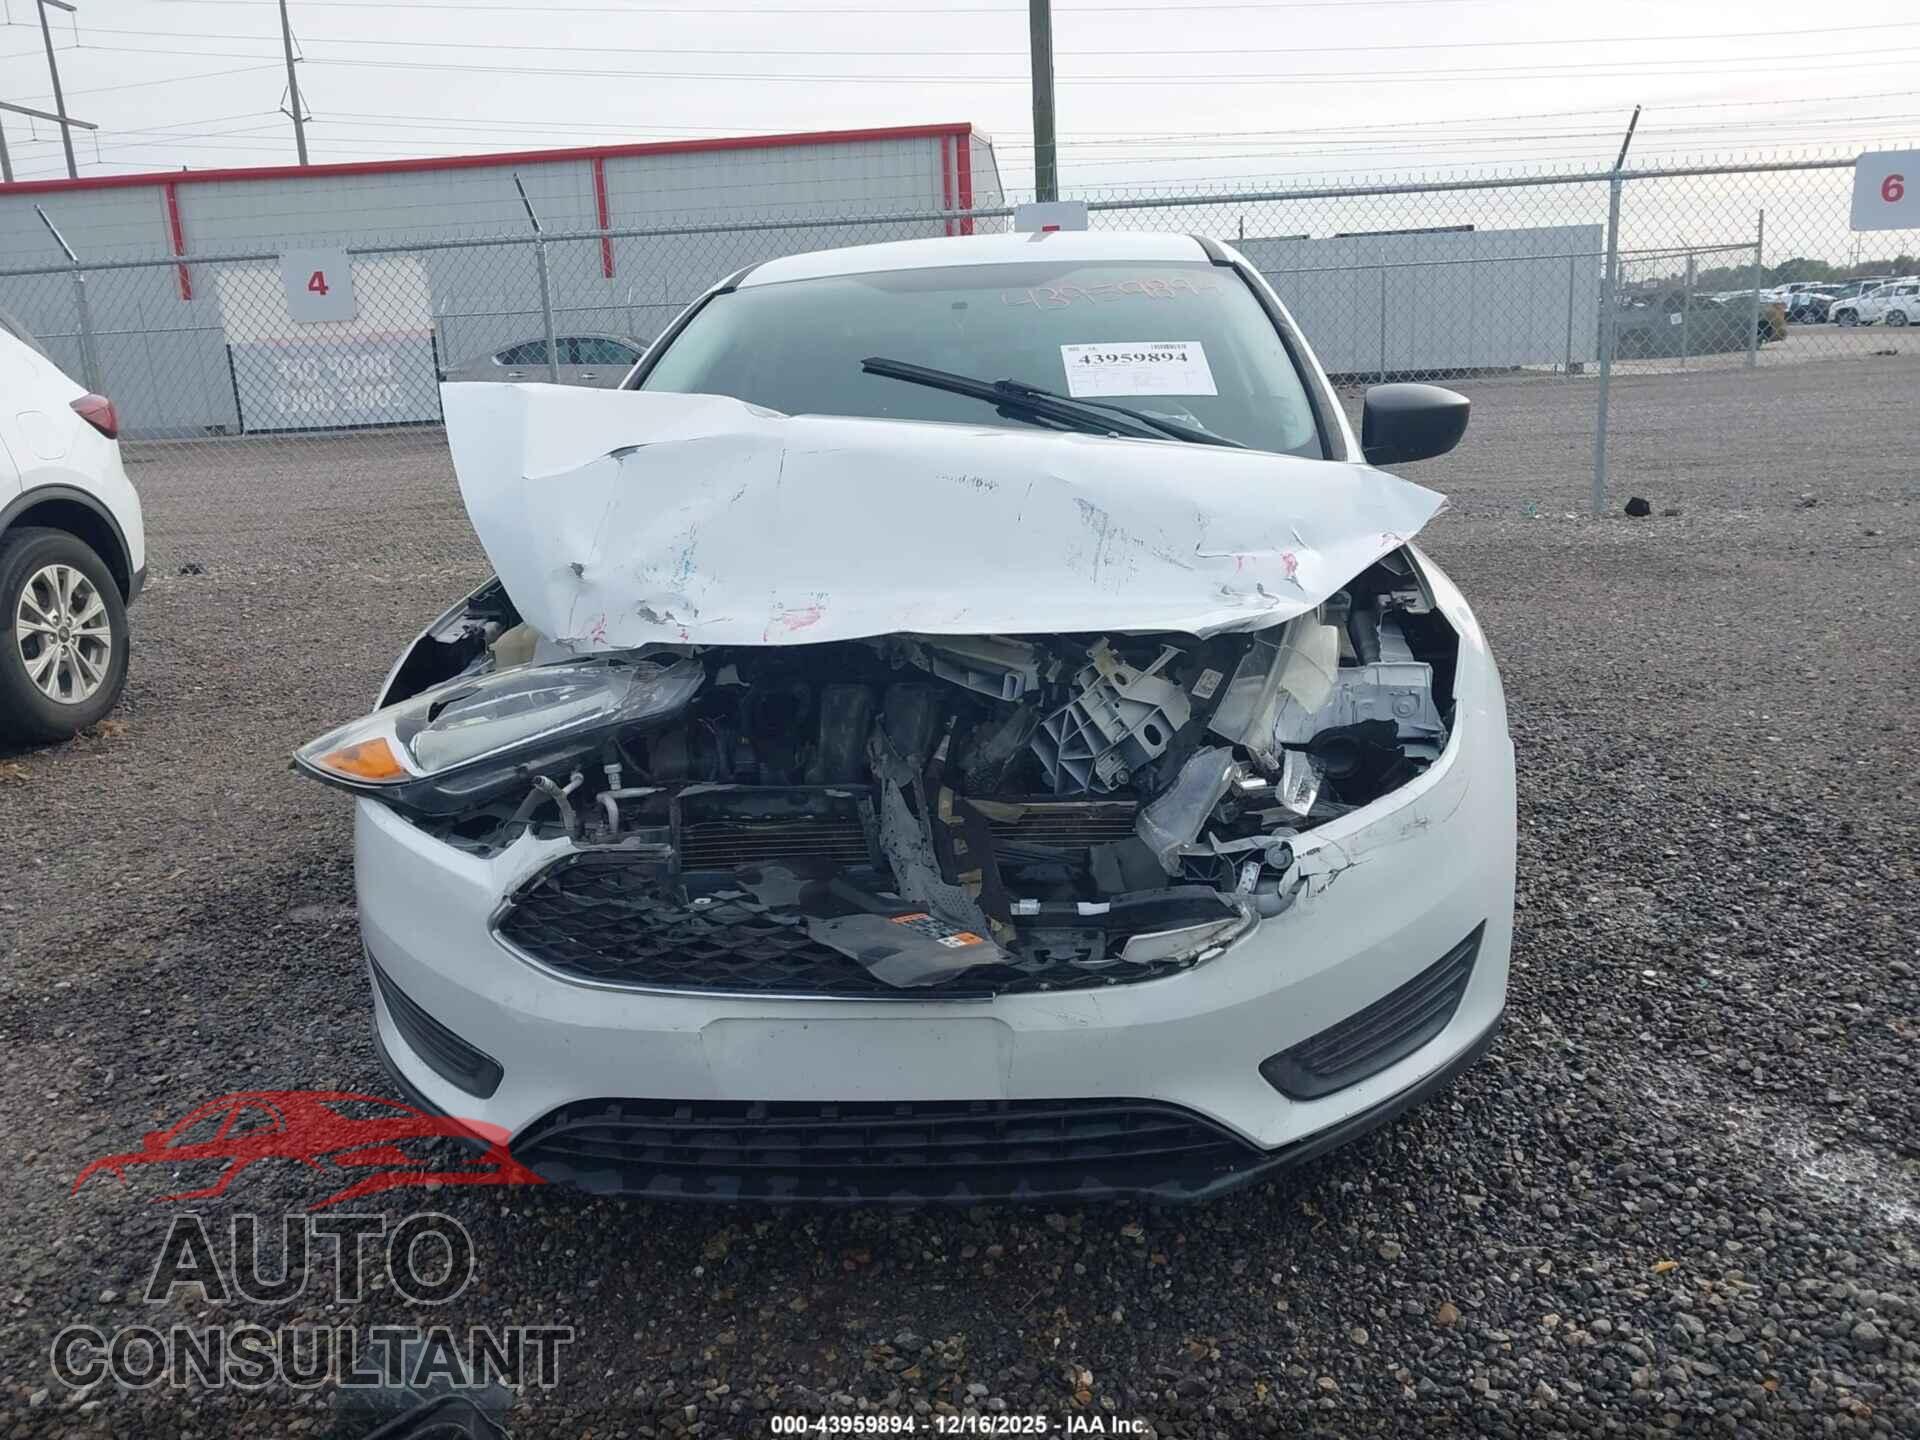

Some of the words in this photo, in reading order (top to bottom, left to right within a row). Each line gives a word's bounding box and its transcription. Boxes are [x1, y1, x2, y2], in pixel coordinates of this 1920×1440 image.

[1881, 174, 1904, 202] 6
[308, 271, 328, 295] 4
[1078, 352, 1188, 365] 43959894
